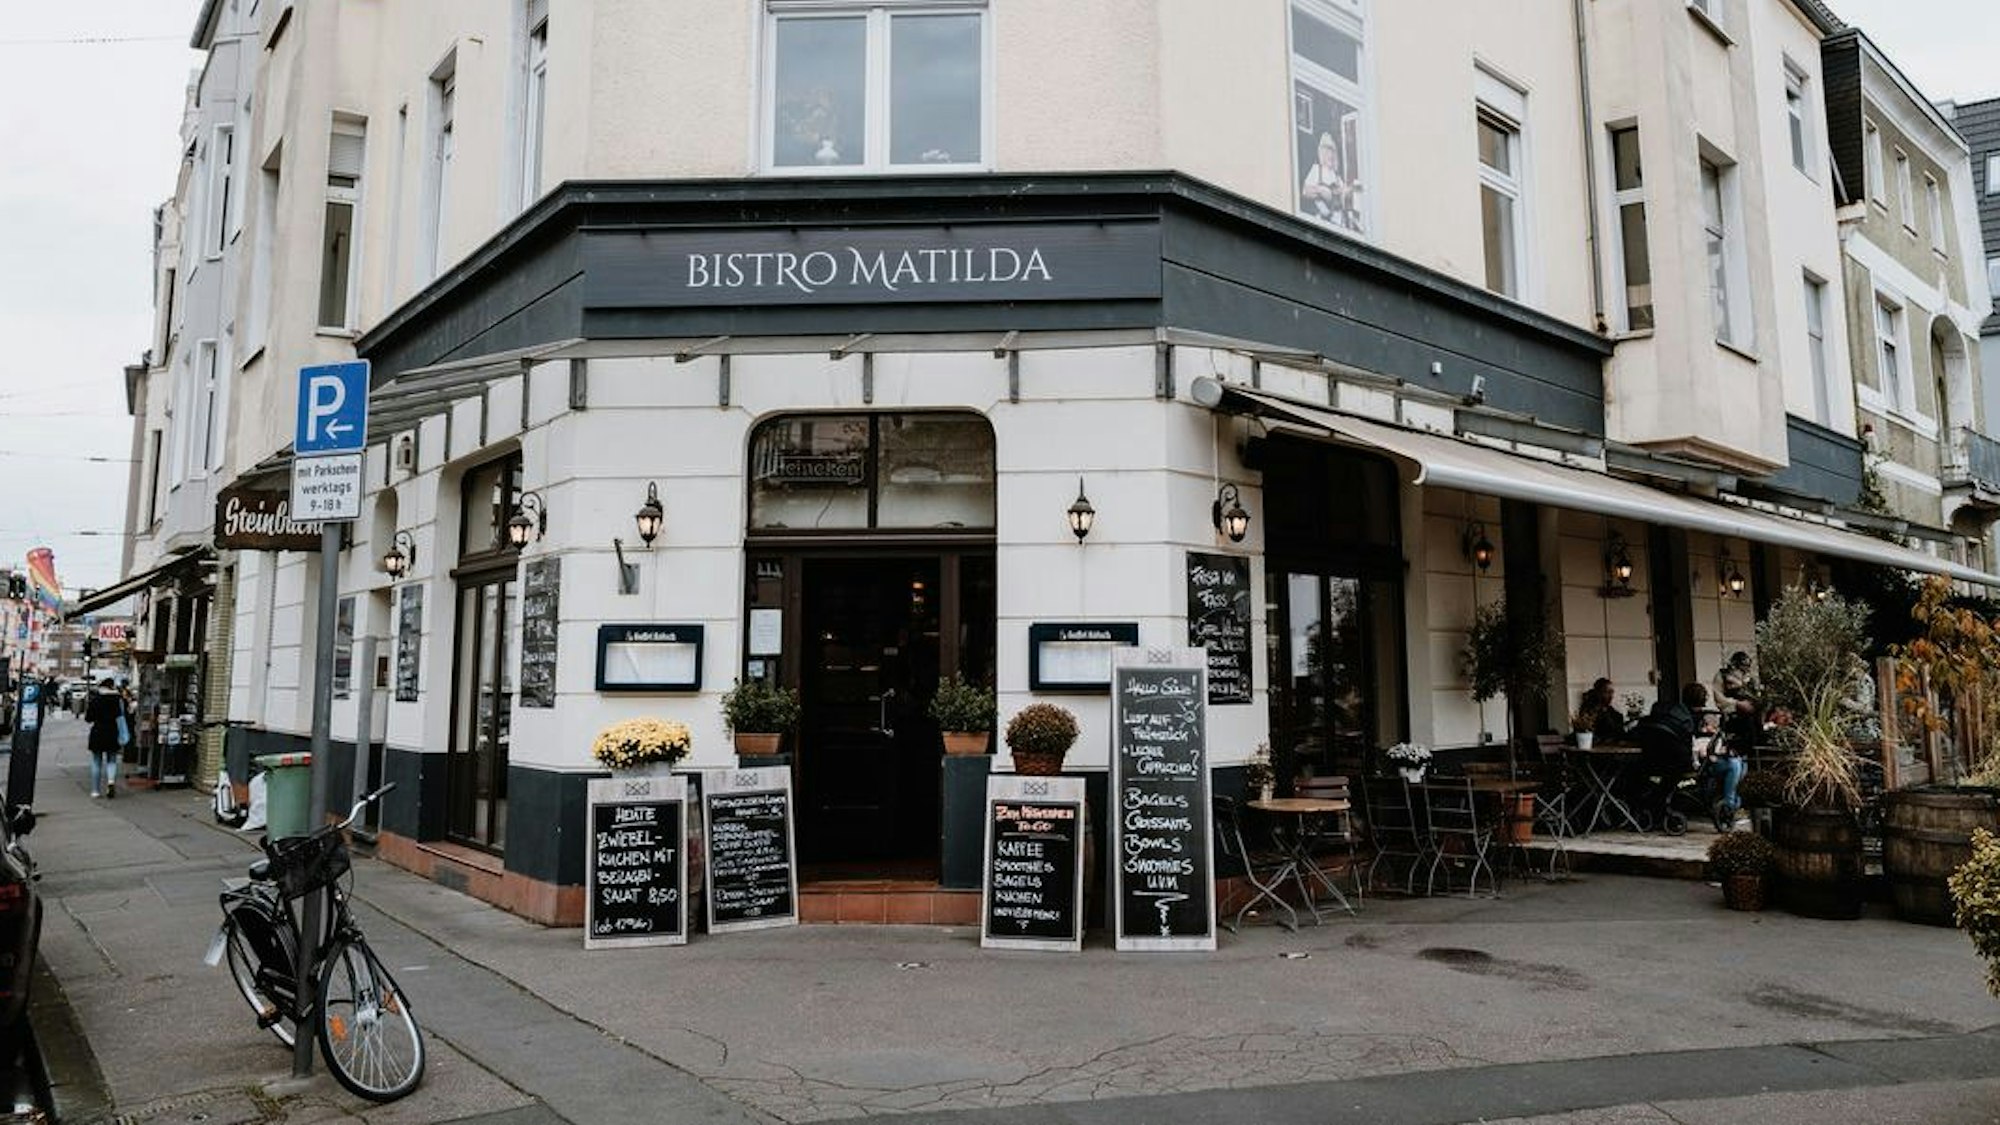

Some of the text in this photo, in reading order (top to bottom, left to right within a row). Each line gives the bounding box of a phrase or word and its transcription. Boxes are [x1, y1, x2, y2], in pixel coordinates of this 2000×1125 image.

[686, 247, 1053, 293] BISTRO MATILDA
[307, 375, 346, 442] P
[298, 463, 358, 479] mit Parkschein
[301, 482, 352, 496] werktags
[101, 624, 126, 638] KIOS
[1123, 707, 1172, 727] LUST AUF
[1123, 786, 1189, 810] BAGELS
[615, 807, 656, 822] HEUTE
[1125, 809, 1192, 832] CROISSANTS
[997, 840, 1044, 858] KAFFEE
[1123, 833, 1182, 855] BOWLS
[598, 850, 650, 867] KUCHEN
[1124, 855, 1194, 875] SMOOTHIES
[993, 872, 1042, 889] BAGELS
[602, 886, 677, 907] SALAT 8,50
[995, 890, 1042, 905] KUCHEN
